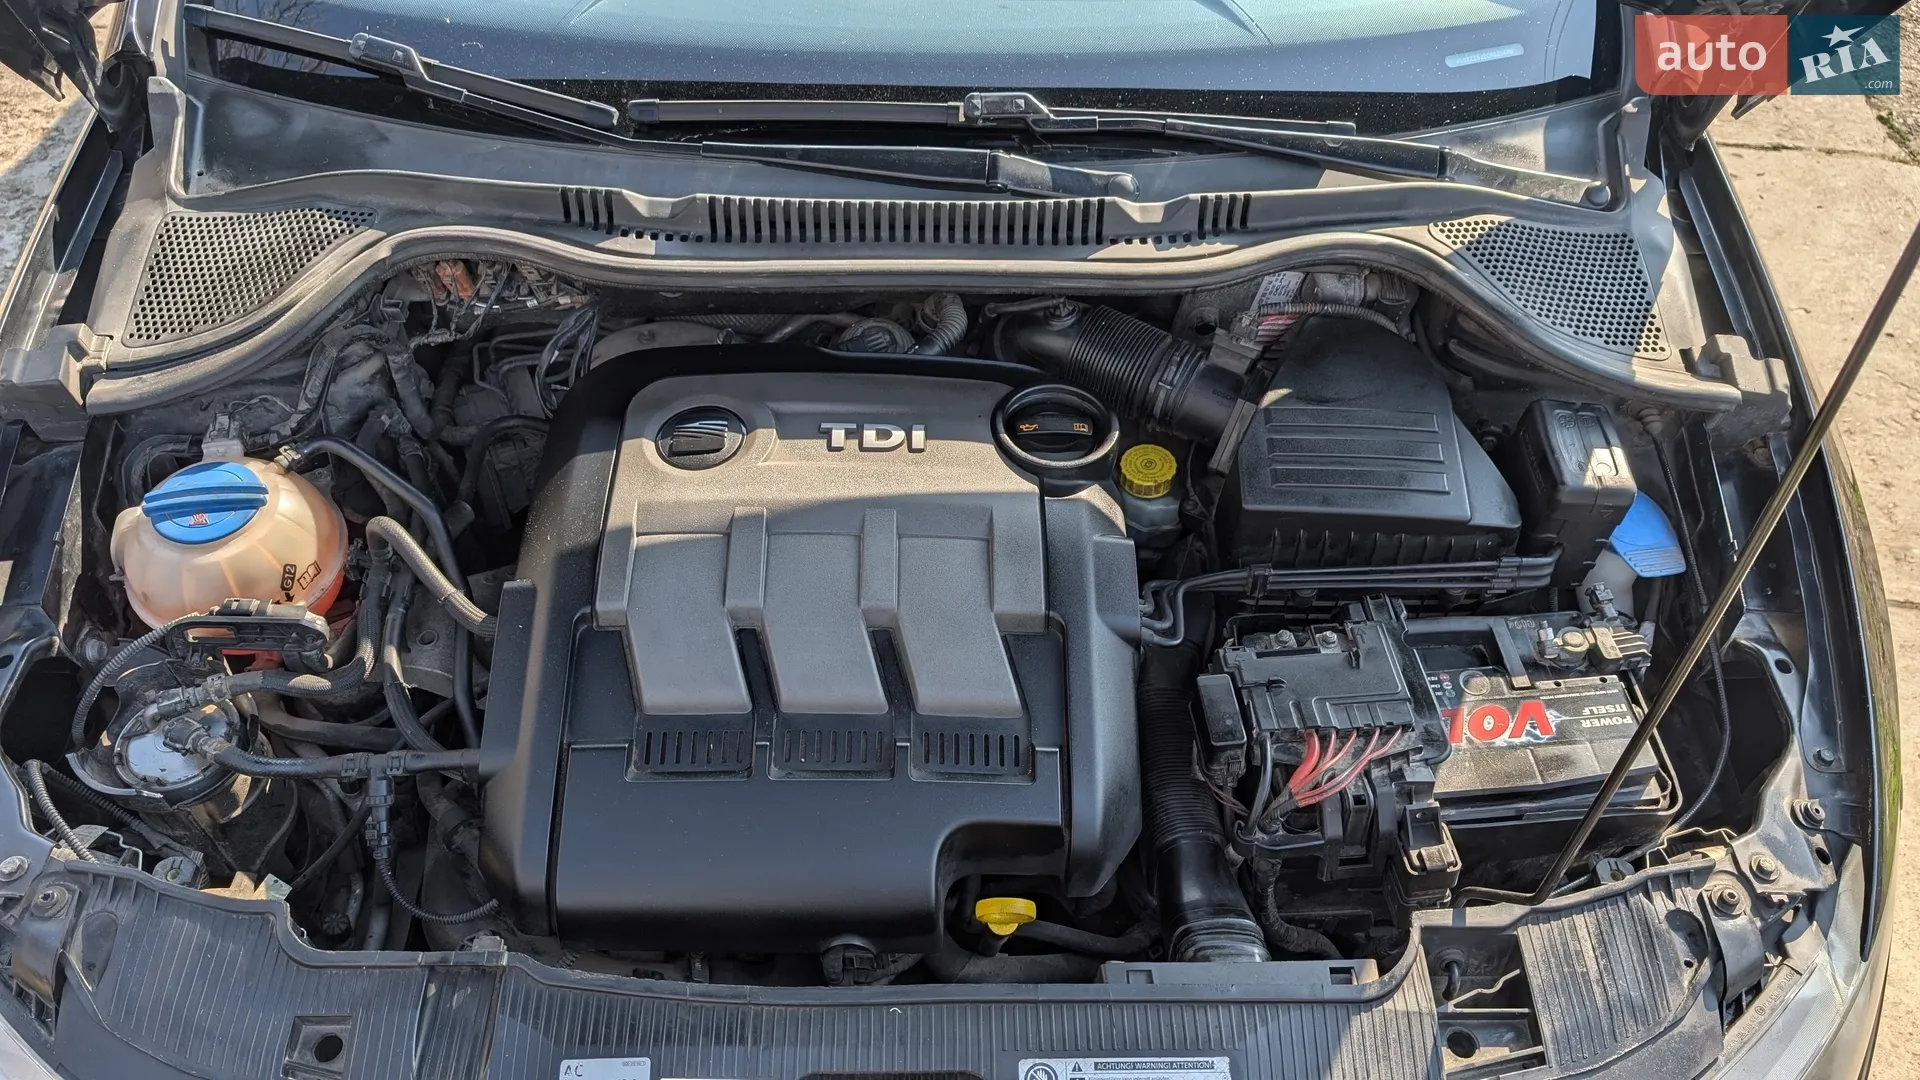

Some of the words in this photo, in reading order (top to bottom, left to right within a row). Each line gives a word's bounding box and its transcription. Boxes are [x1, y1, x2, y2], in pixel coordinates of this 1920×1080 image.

[819, 422, 926, 453] TDI
[284, 565, 296, 588] G12
[1582, 703, 1627, 716] ITSELF
[1441, 700, 1555, 745] VOL
[1581, 715, 1633, 729] POWER
[563, 1063, 584, 1077] AC
[1135, 1061, 1171, 1070] WARNING!
[1172, 1060, 1213, 1069] ATTENTION!
